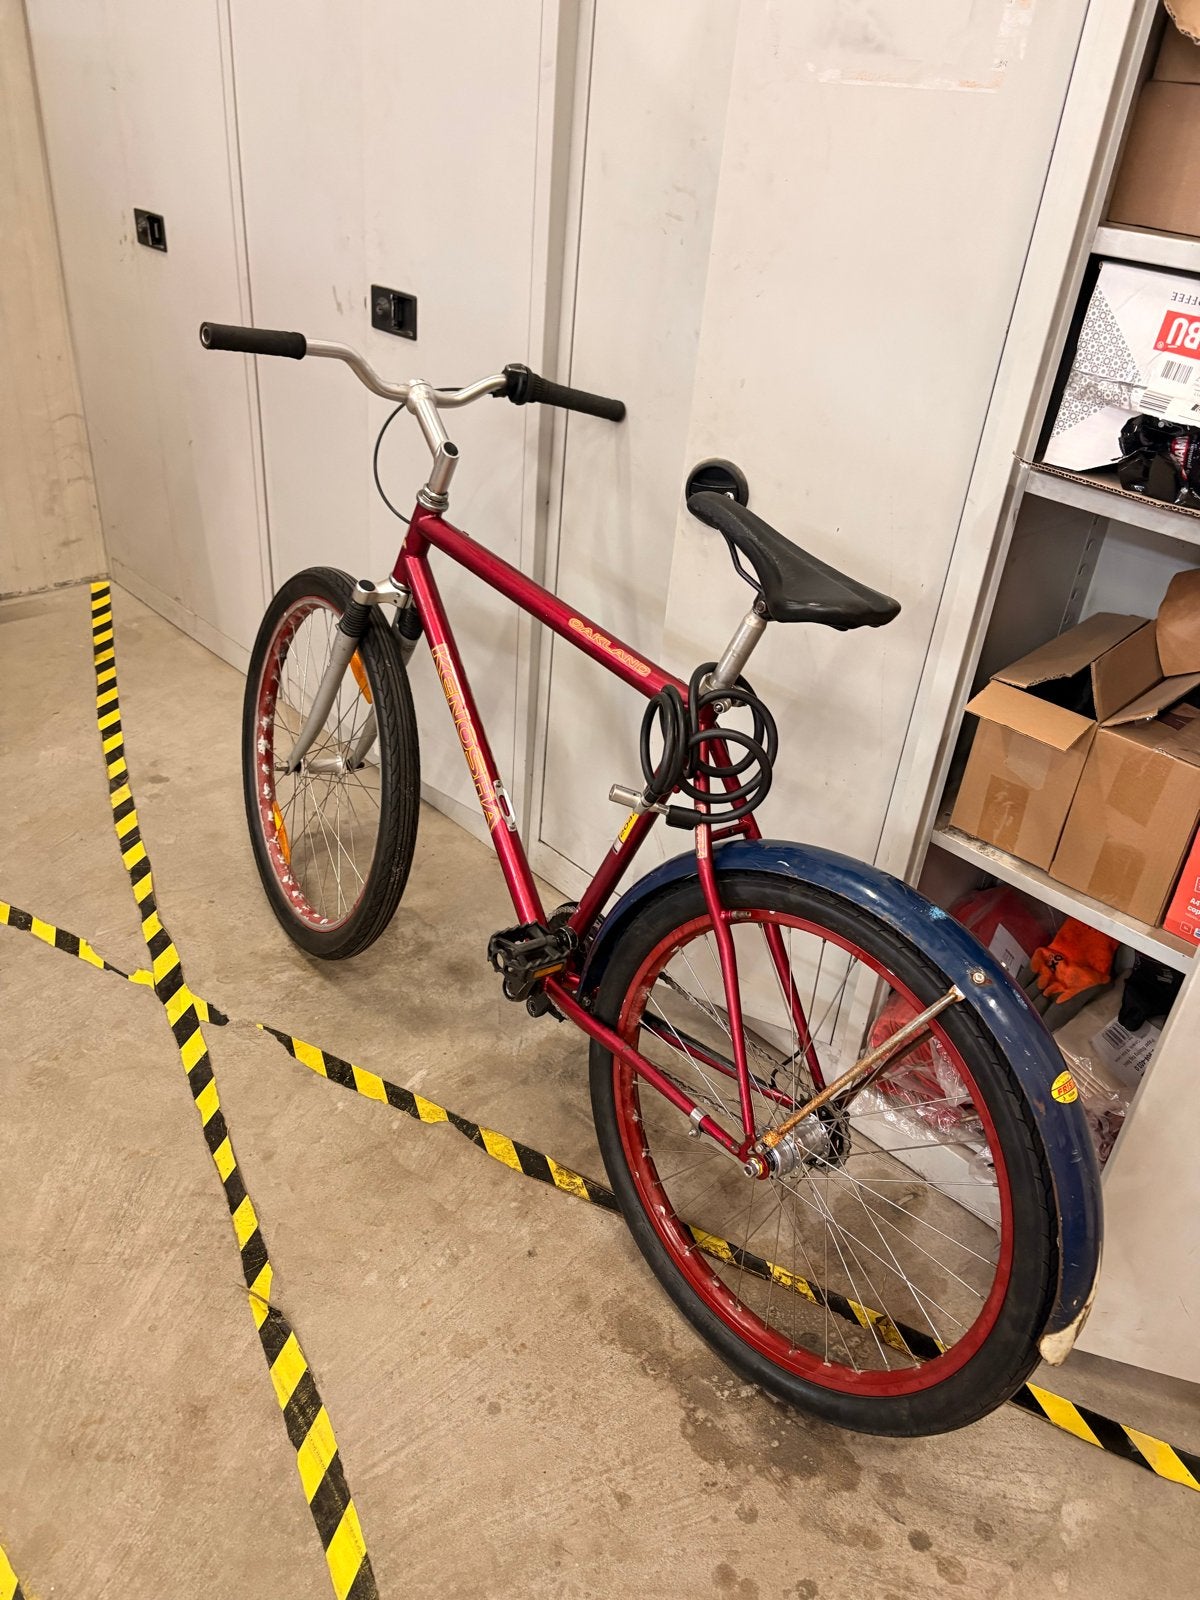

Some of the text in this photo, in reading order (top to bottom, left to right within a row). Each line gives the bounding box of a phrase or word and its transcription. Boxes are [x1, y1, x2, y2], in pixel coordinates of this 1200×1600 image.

[1170, 291, 1200, 306] FFEE
[568, 618, 651, 677] OAKLAND
[432, 642, 500, 833] KENOSHA
